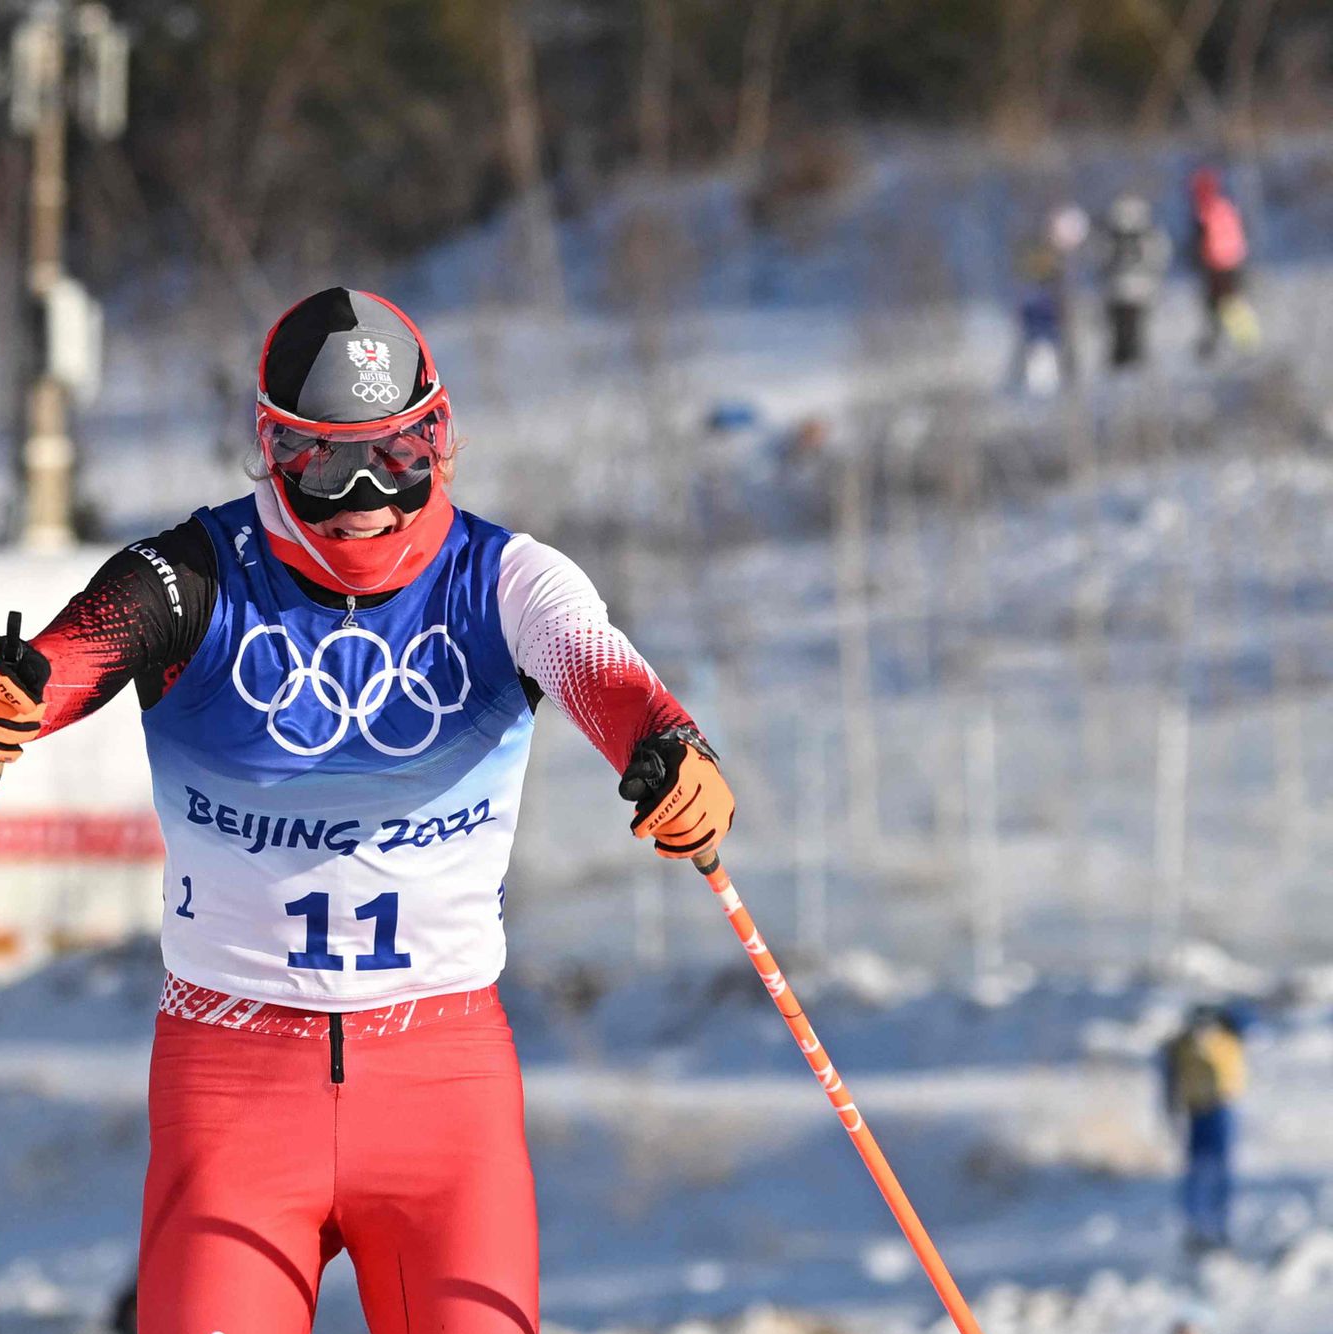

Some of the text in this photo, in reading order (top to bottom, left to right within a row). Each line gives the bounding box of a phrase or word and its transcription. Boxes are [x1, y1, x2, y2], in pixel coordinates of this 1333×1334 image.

[359, 372, 392, 383] AUSTRIA
[185, 785, 497, 856] BEIJING 2022
[285, 892, 411, 971] 11
